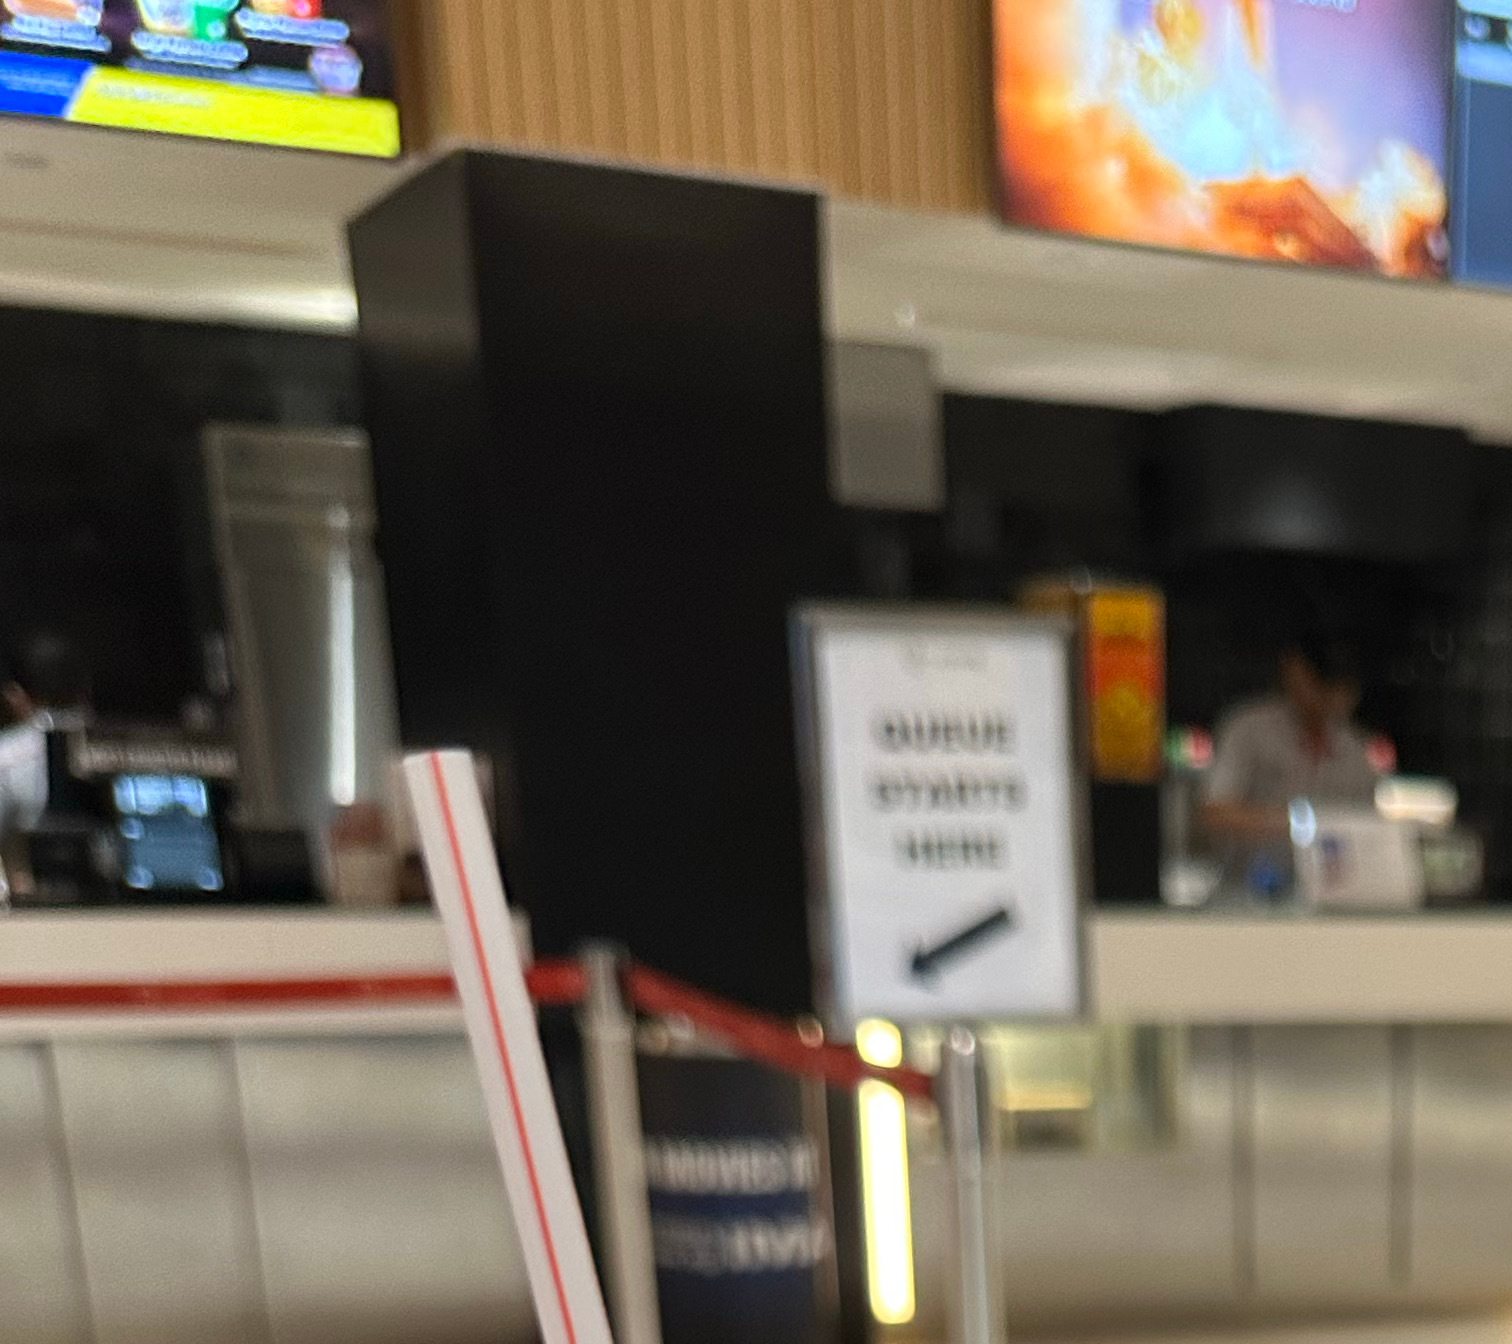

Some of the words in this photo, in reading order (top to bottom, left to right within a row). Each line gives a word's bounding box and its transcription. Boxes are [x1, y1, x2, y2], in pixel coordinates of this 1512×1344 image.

[877, 706, 1014, 754] QUEUE
[867, 769, 1028, 812] STARTS
[896, 831, 1010, 871] HERE
